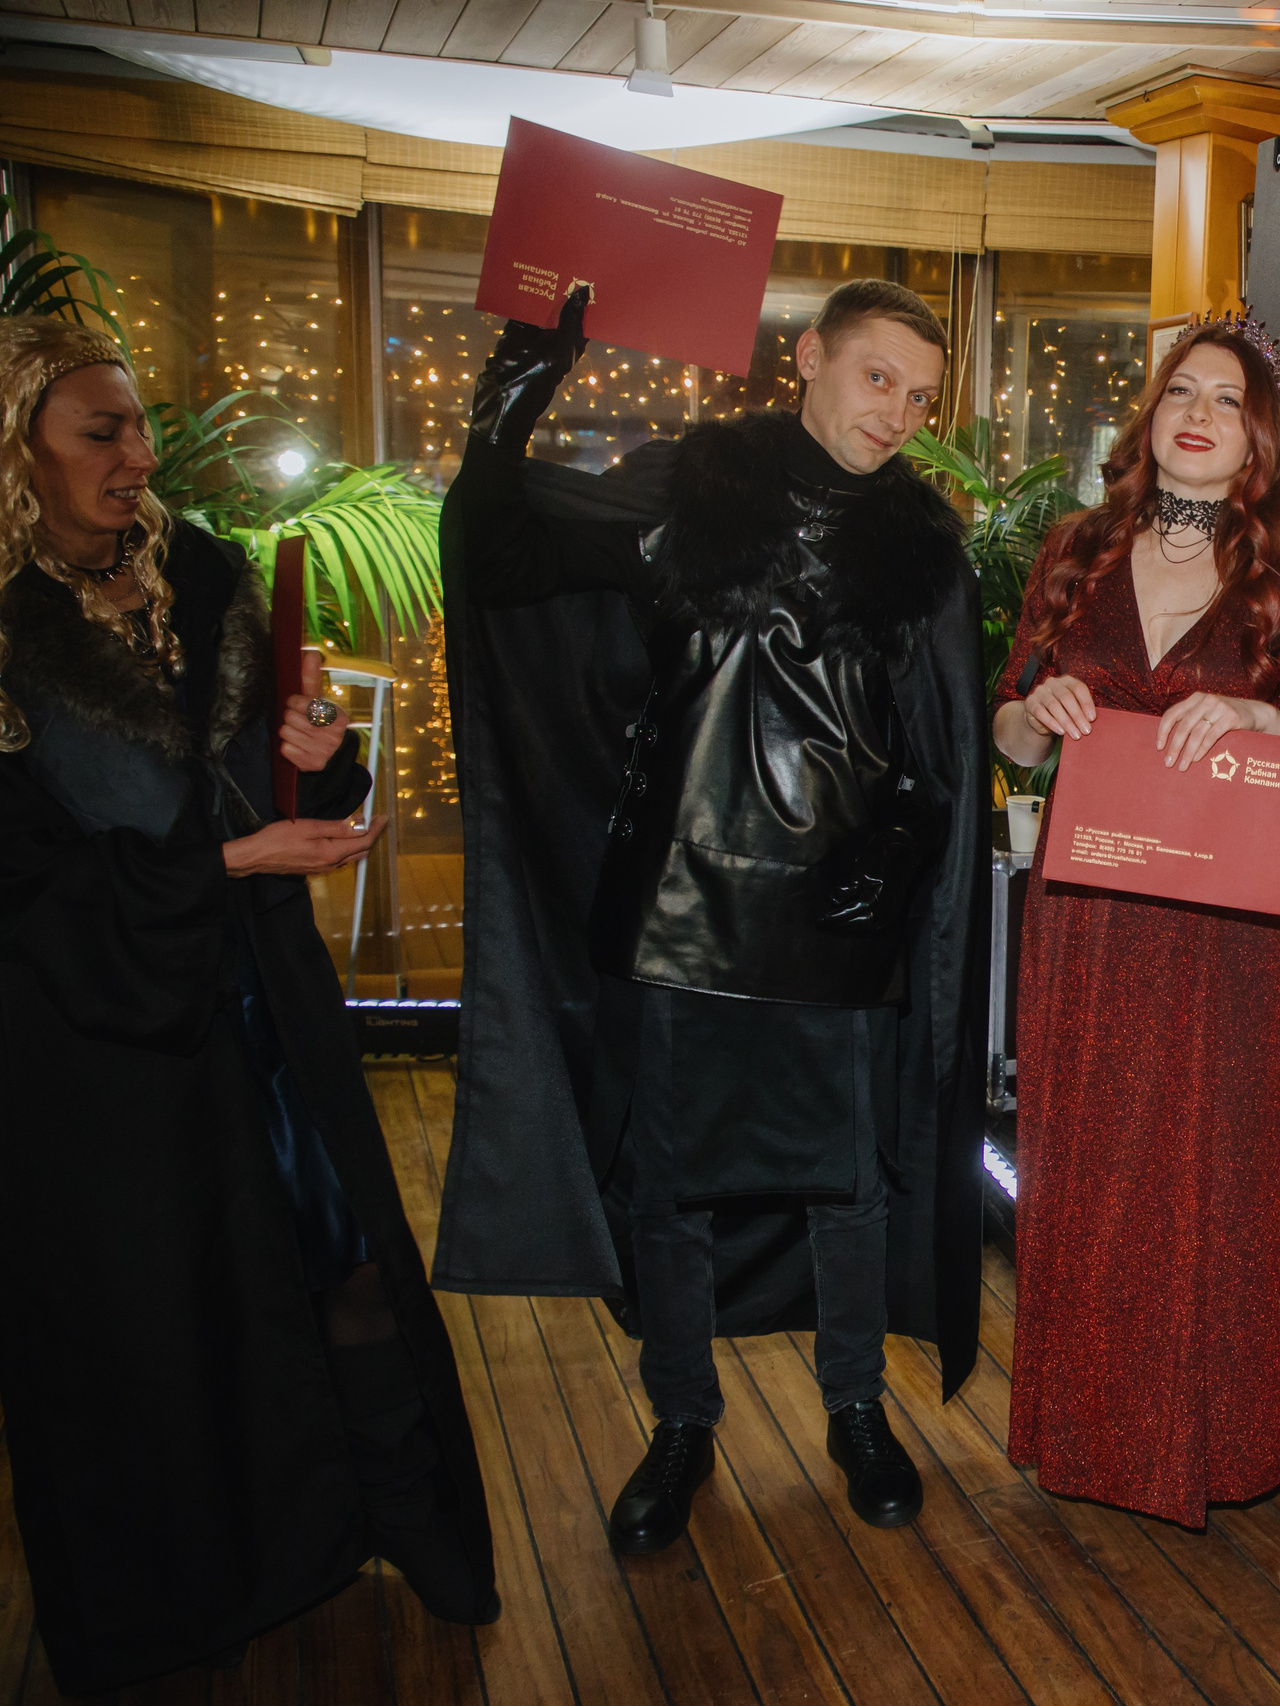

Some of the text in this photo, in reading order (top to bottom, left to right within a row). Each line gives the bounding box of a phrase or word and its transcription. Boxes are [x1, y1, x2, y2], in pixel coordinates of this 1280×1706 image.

[513, 262, 559, 281] Компания
[522, 274, 557, 290] Рыбная
[518, 284, 555, 301] Русская
[1247, 757, 1280, 769] Русская
[1246, 766, 1276, 778] Рыбная
